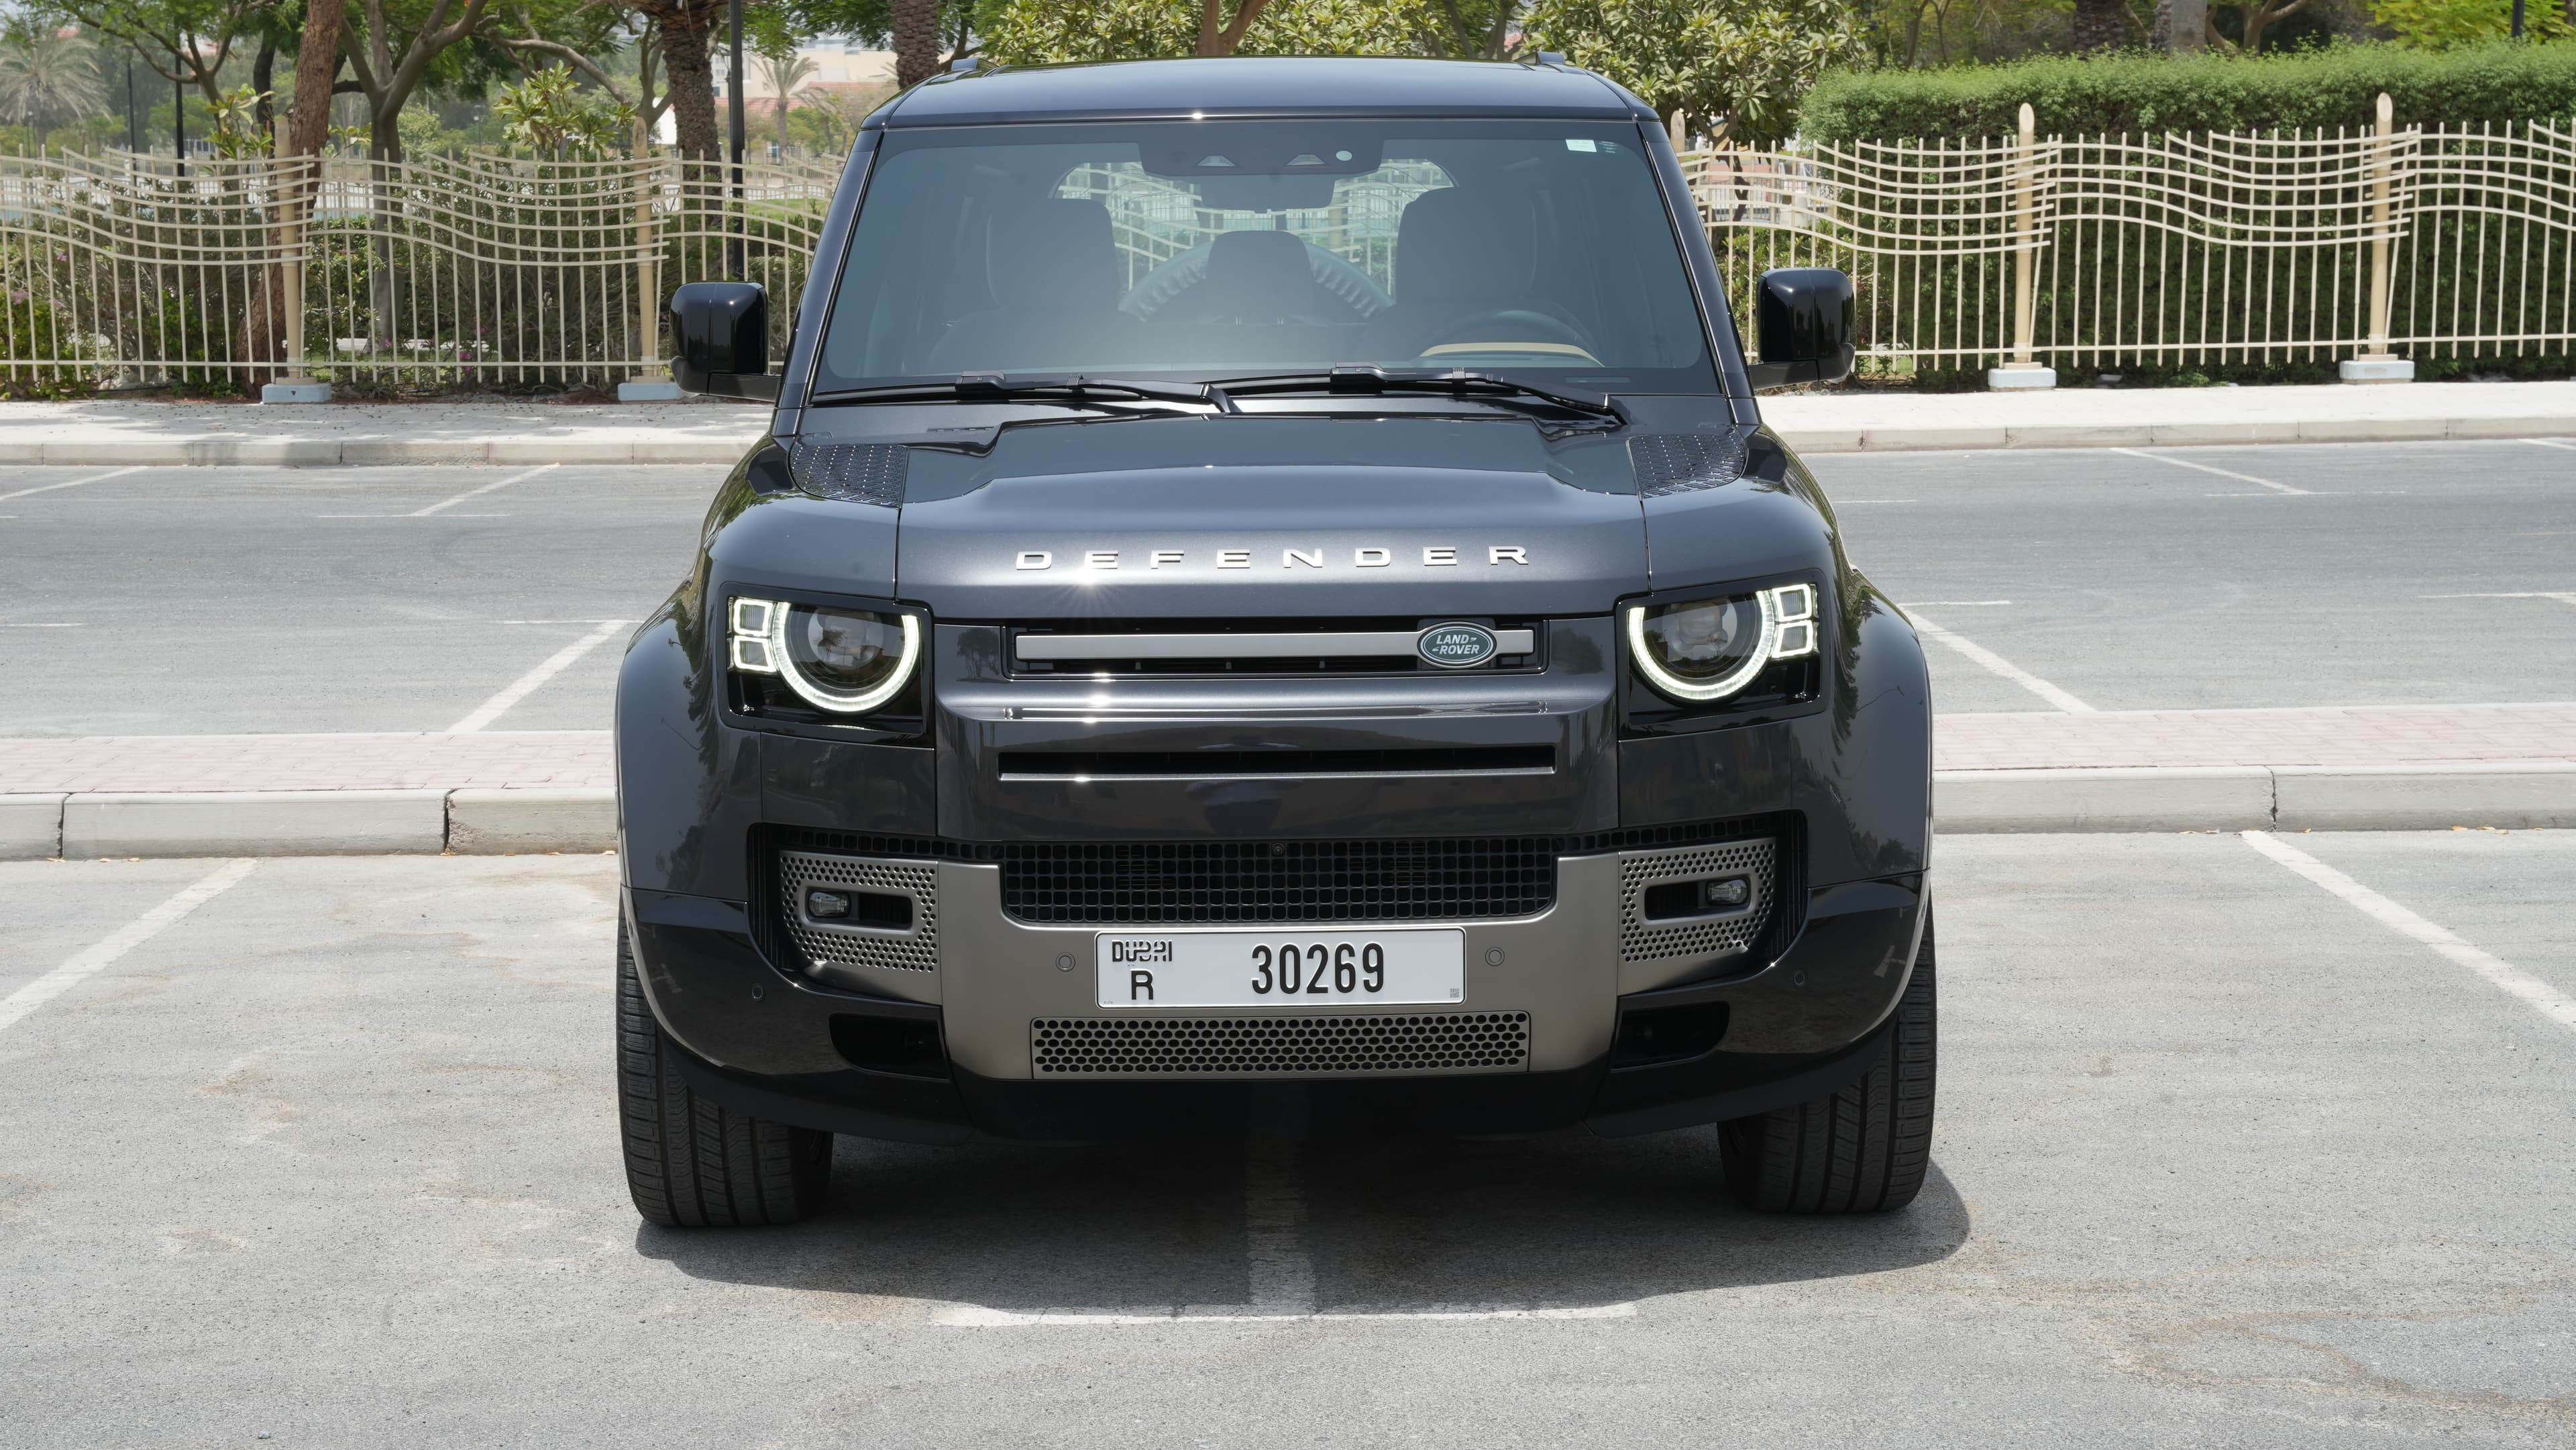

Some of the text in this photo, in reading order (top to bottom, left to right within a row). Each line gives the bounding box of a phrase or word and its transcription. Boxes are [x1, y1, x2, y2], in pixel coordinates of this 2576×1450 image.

[1015, 546, 1529, 570] DEFENDER
[1436, 635, 1469, 644] LAND
[1439, 645, 1480, 654] ROVER
[1252, 943, 1384, 994] 30269
[1131, 970, 1154, 1000] R
